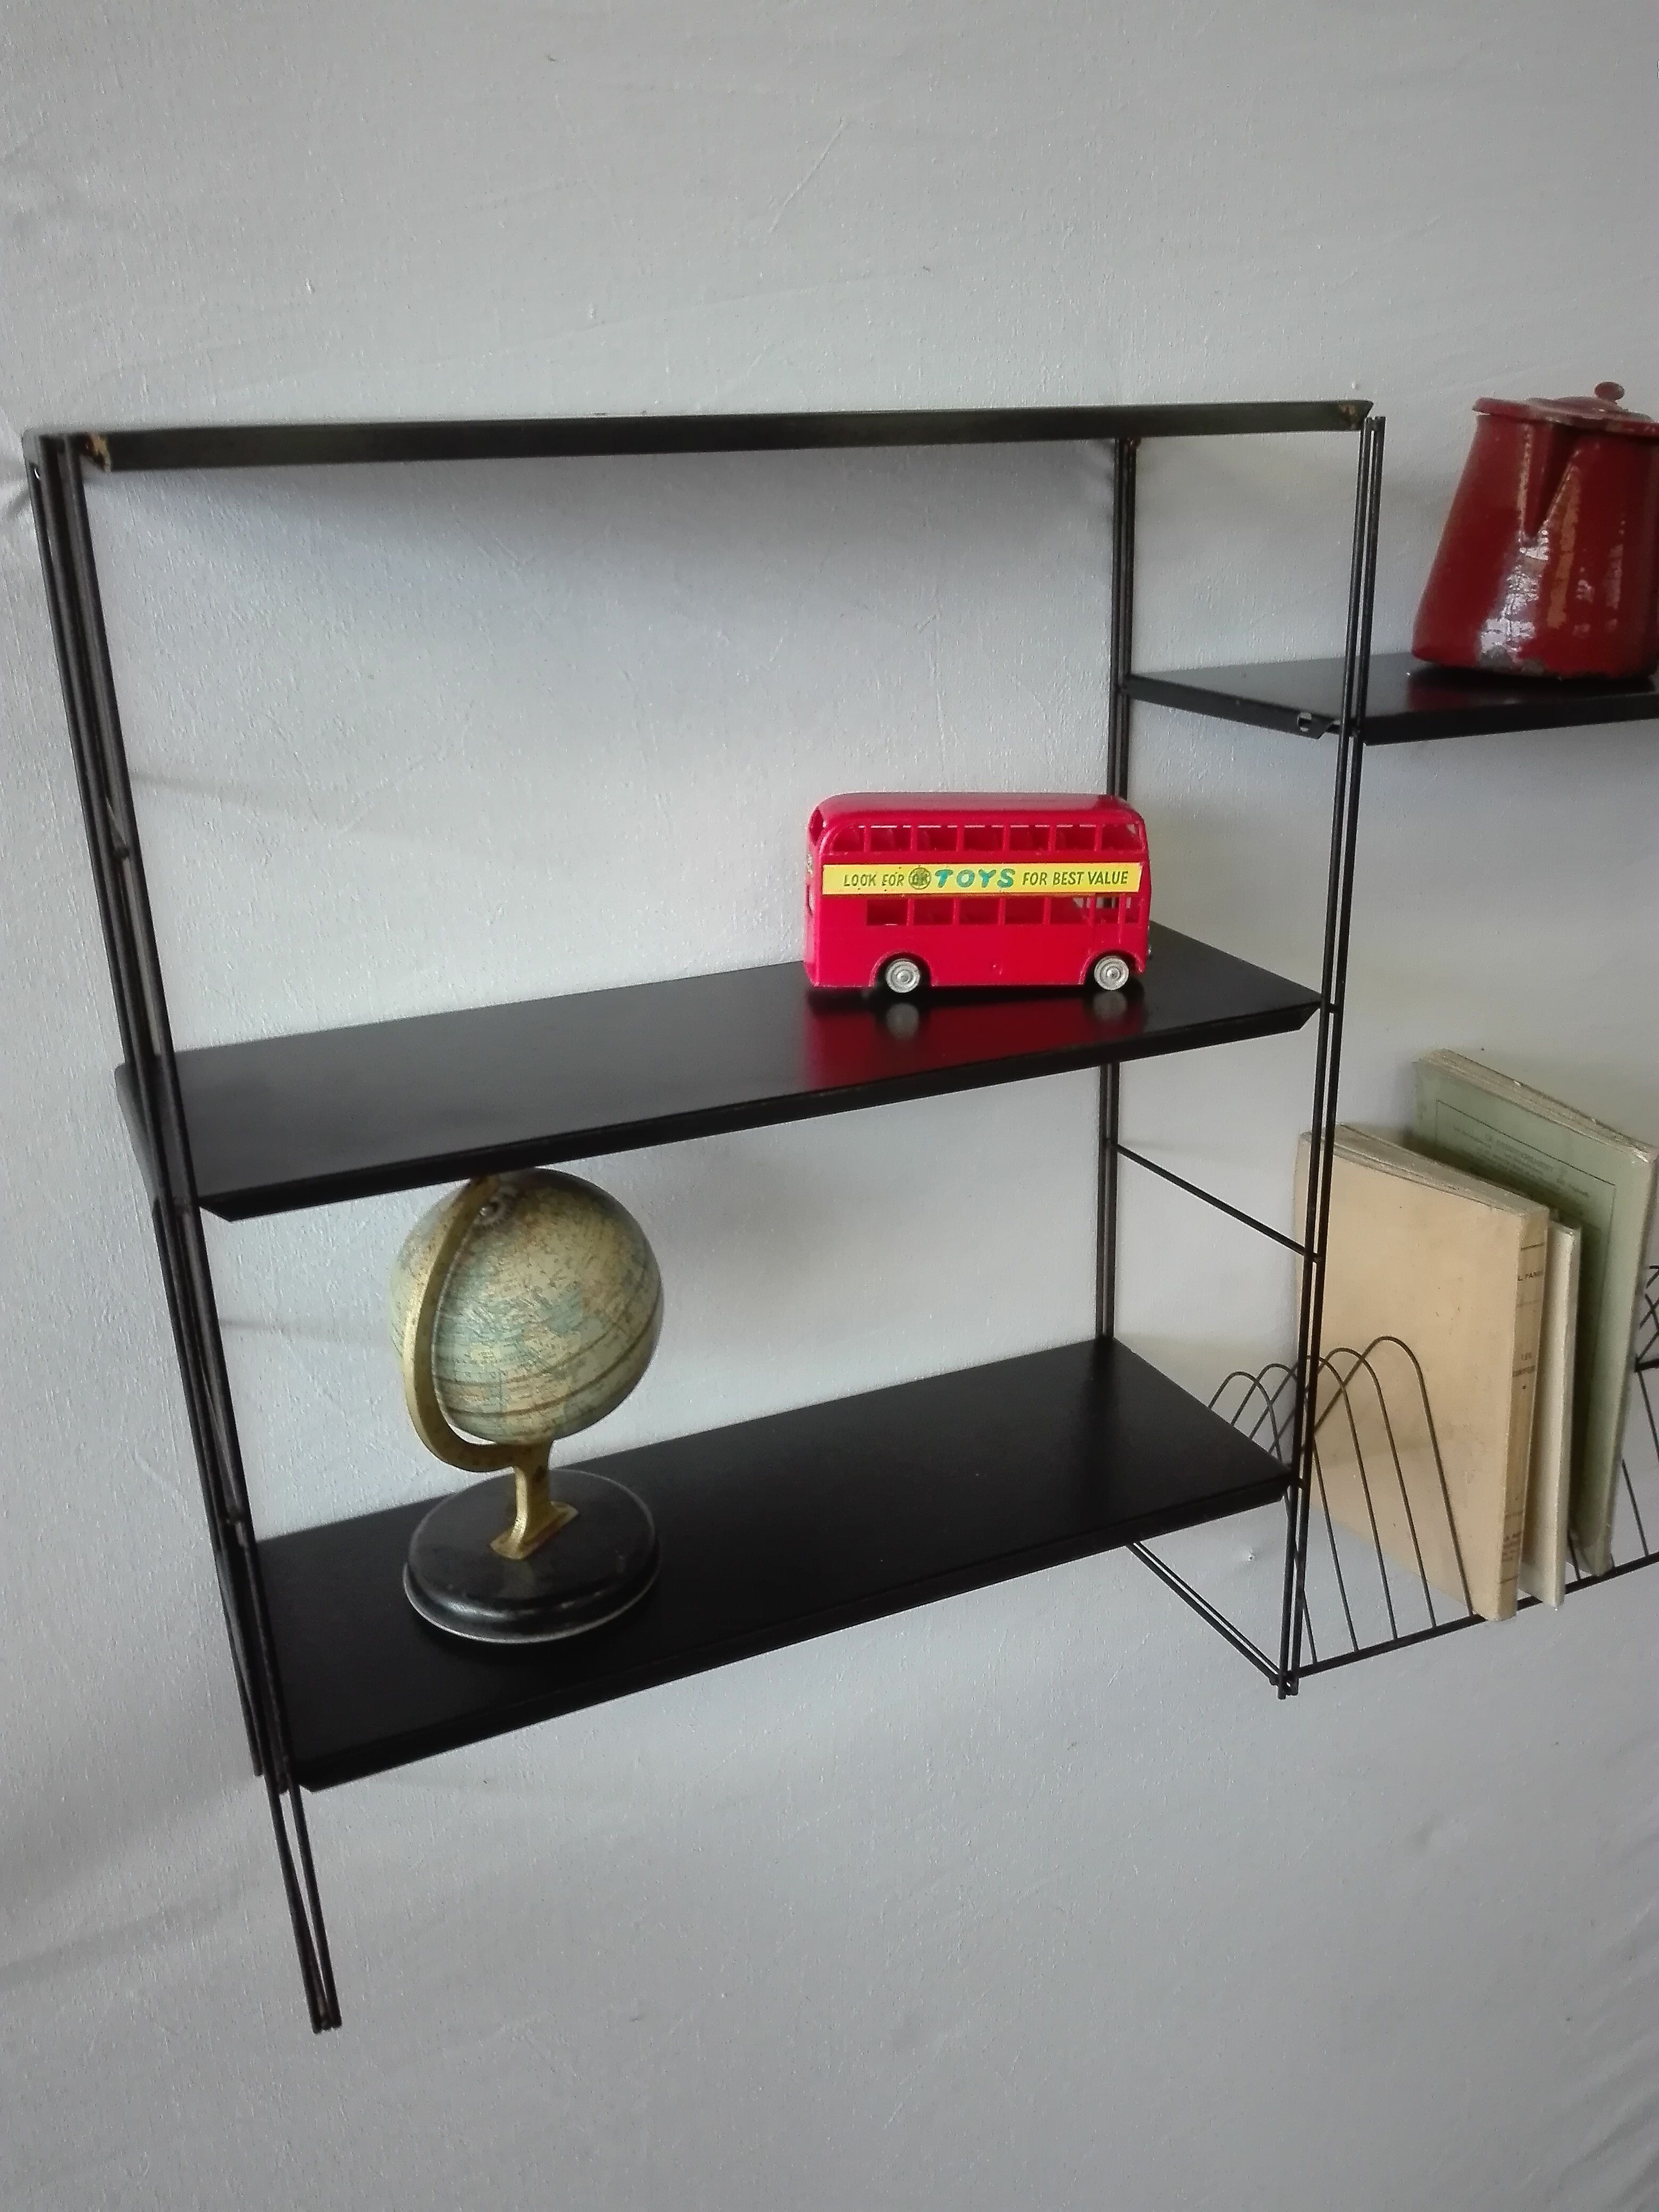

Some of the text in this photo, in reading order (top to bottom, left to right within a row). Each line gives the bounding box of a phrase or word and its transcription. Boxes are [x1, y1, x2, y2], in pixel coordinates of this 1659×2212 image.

[844, 874, 876, 886] LOOK
[881, 874, 904, 886] FOR
[935, 869, 1015, 888] TOYS
[1022, 872, 1048, 885] FOR
[1052, 872, 1085, 885] BEST
[1087, 871, 1128, 885] VALUE
